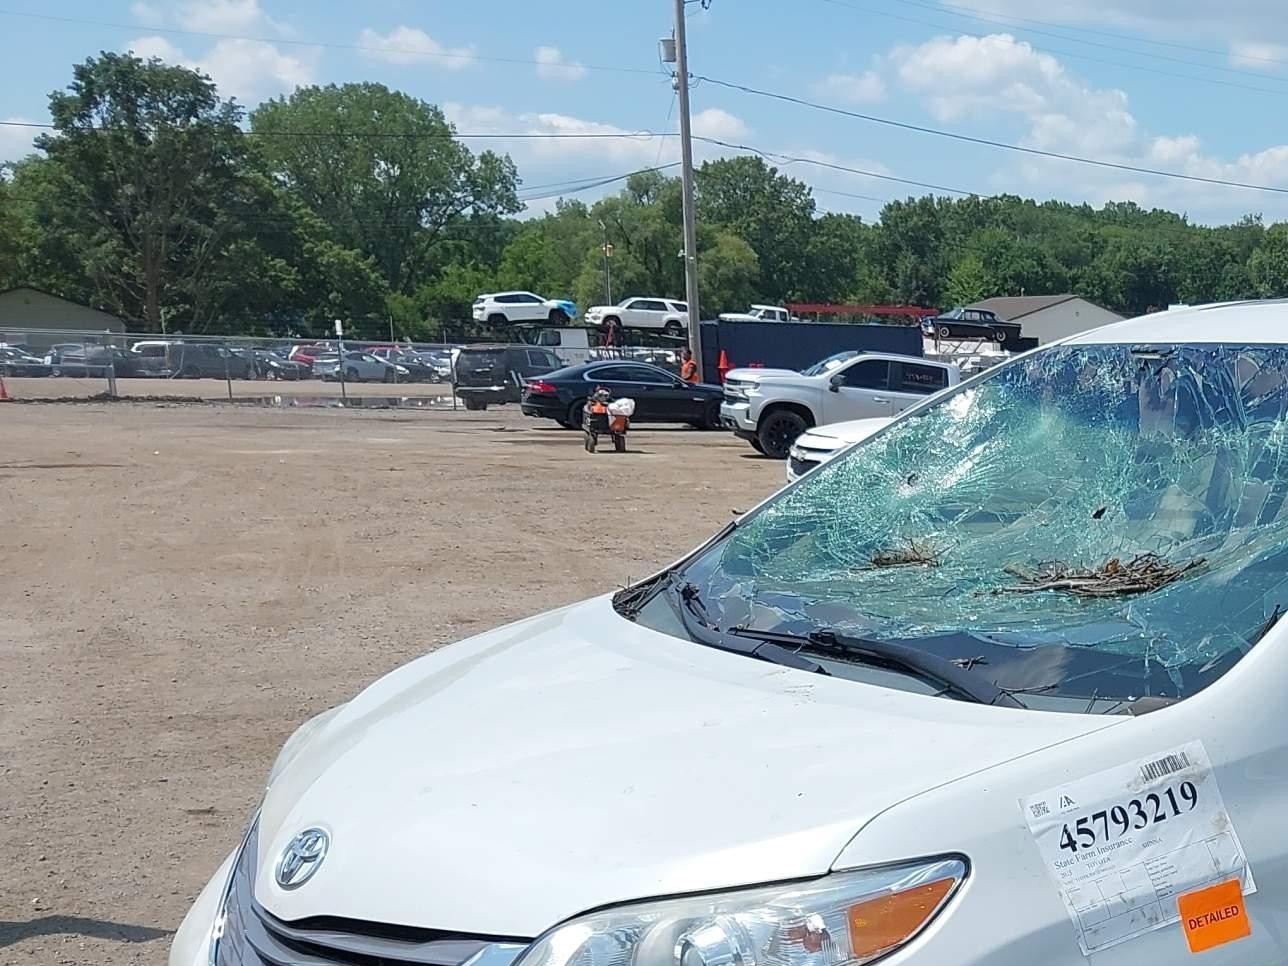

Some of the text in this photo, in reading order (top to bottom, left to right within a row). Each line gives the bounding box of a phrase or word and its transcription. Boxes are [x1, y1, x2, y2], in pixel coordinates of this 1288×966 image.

[1059, 781, 1198, 853] 45793219
[1054, 838, 1133, 870] State Farm Insurance
[1188, 905, 1239, 930] DETAILED
